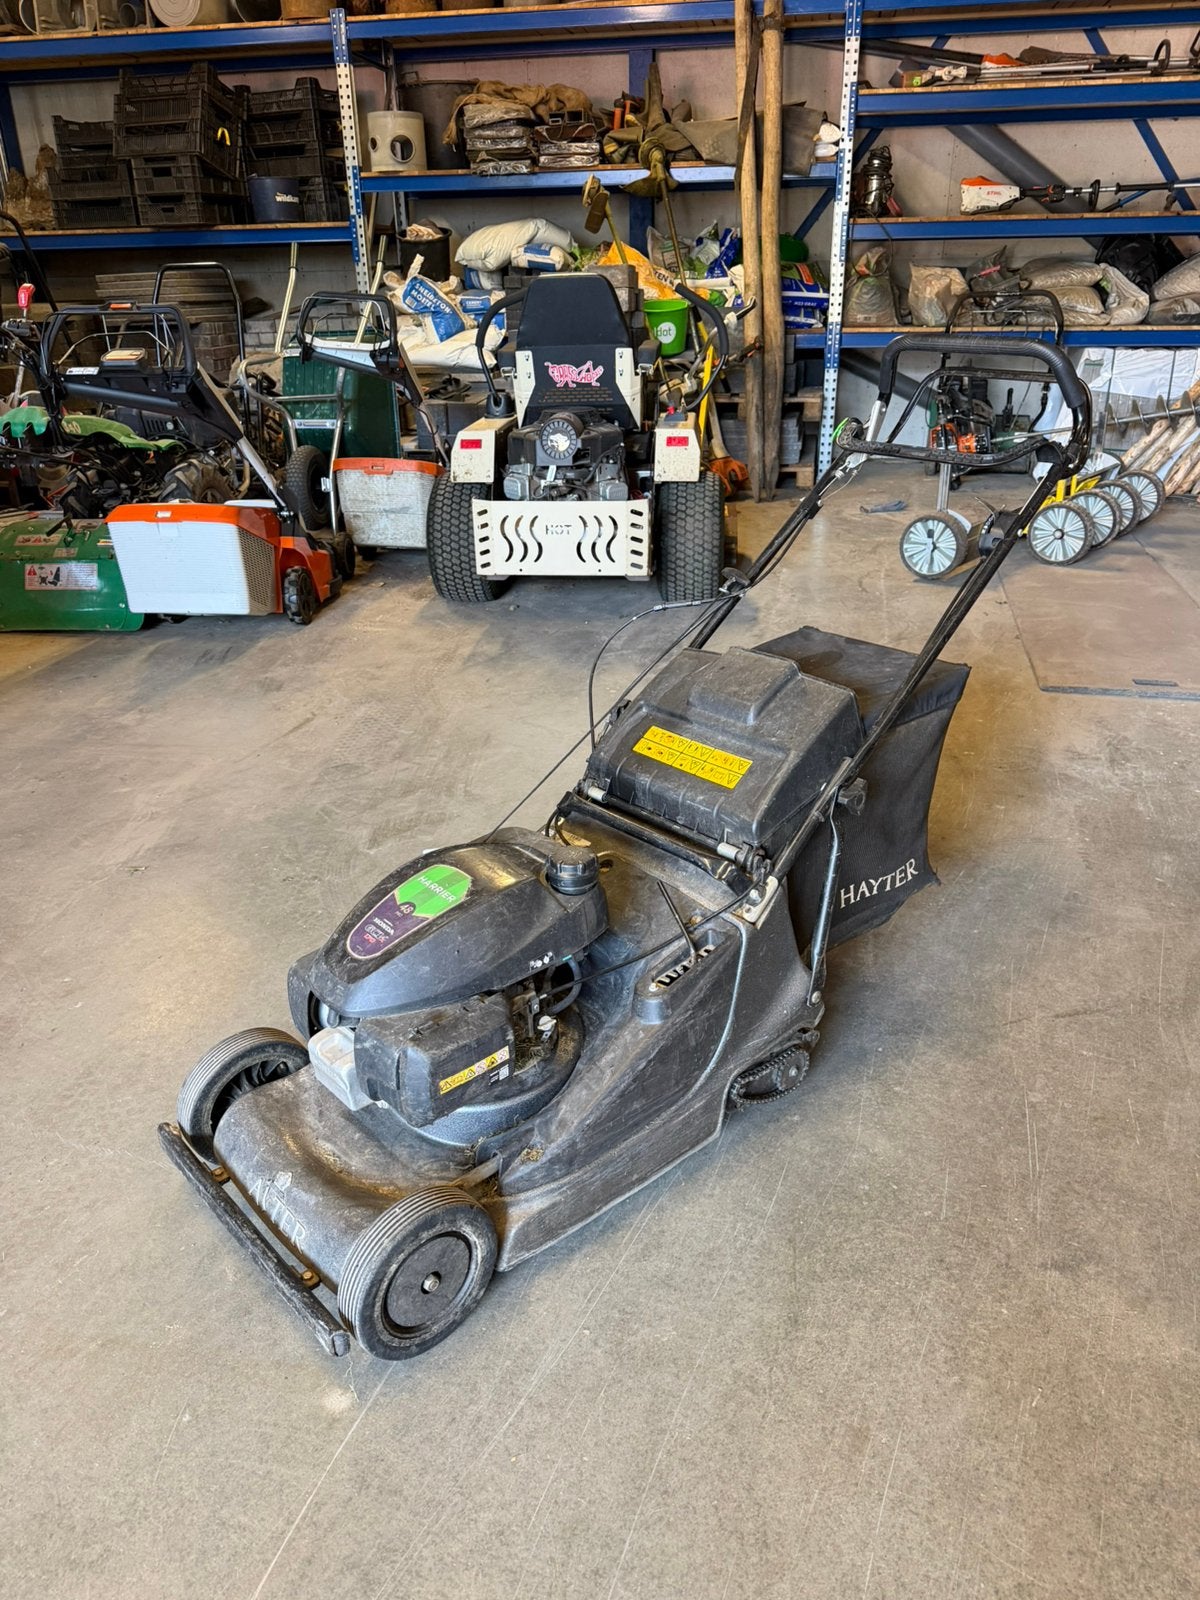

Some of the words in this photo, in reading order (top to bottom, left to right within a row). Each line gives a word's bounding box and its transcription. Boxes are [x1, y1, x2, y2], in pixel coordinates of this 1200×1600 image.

[545, 524, 573, 535] HOT
[417, 876, 457, 902] HARRIER
[840, 858, 919, 909] HAYTER
[399, 904, 414, 914] 48
[373, 917, 395, 936] HONDA
